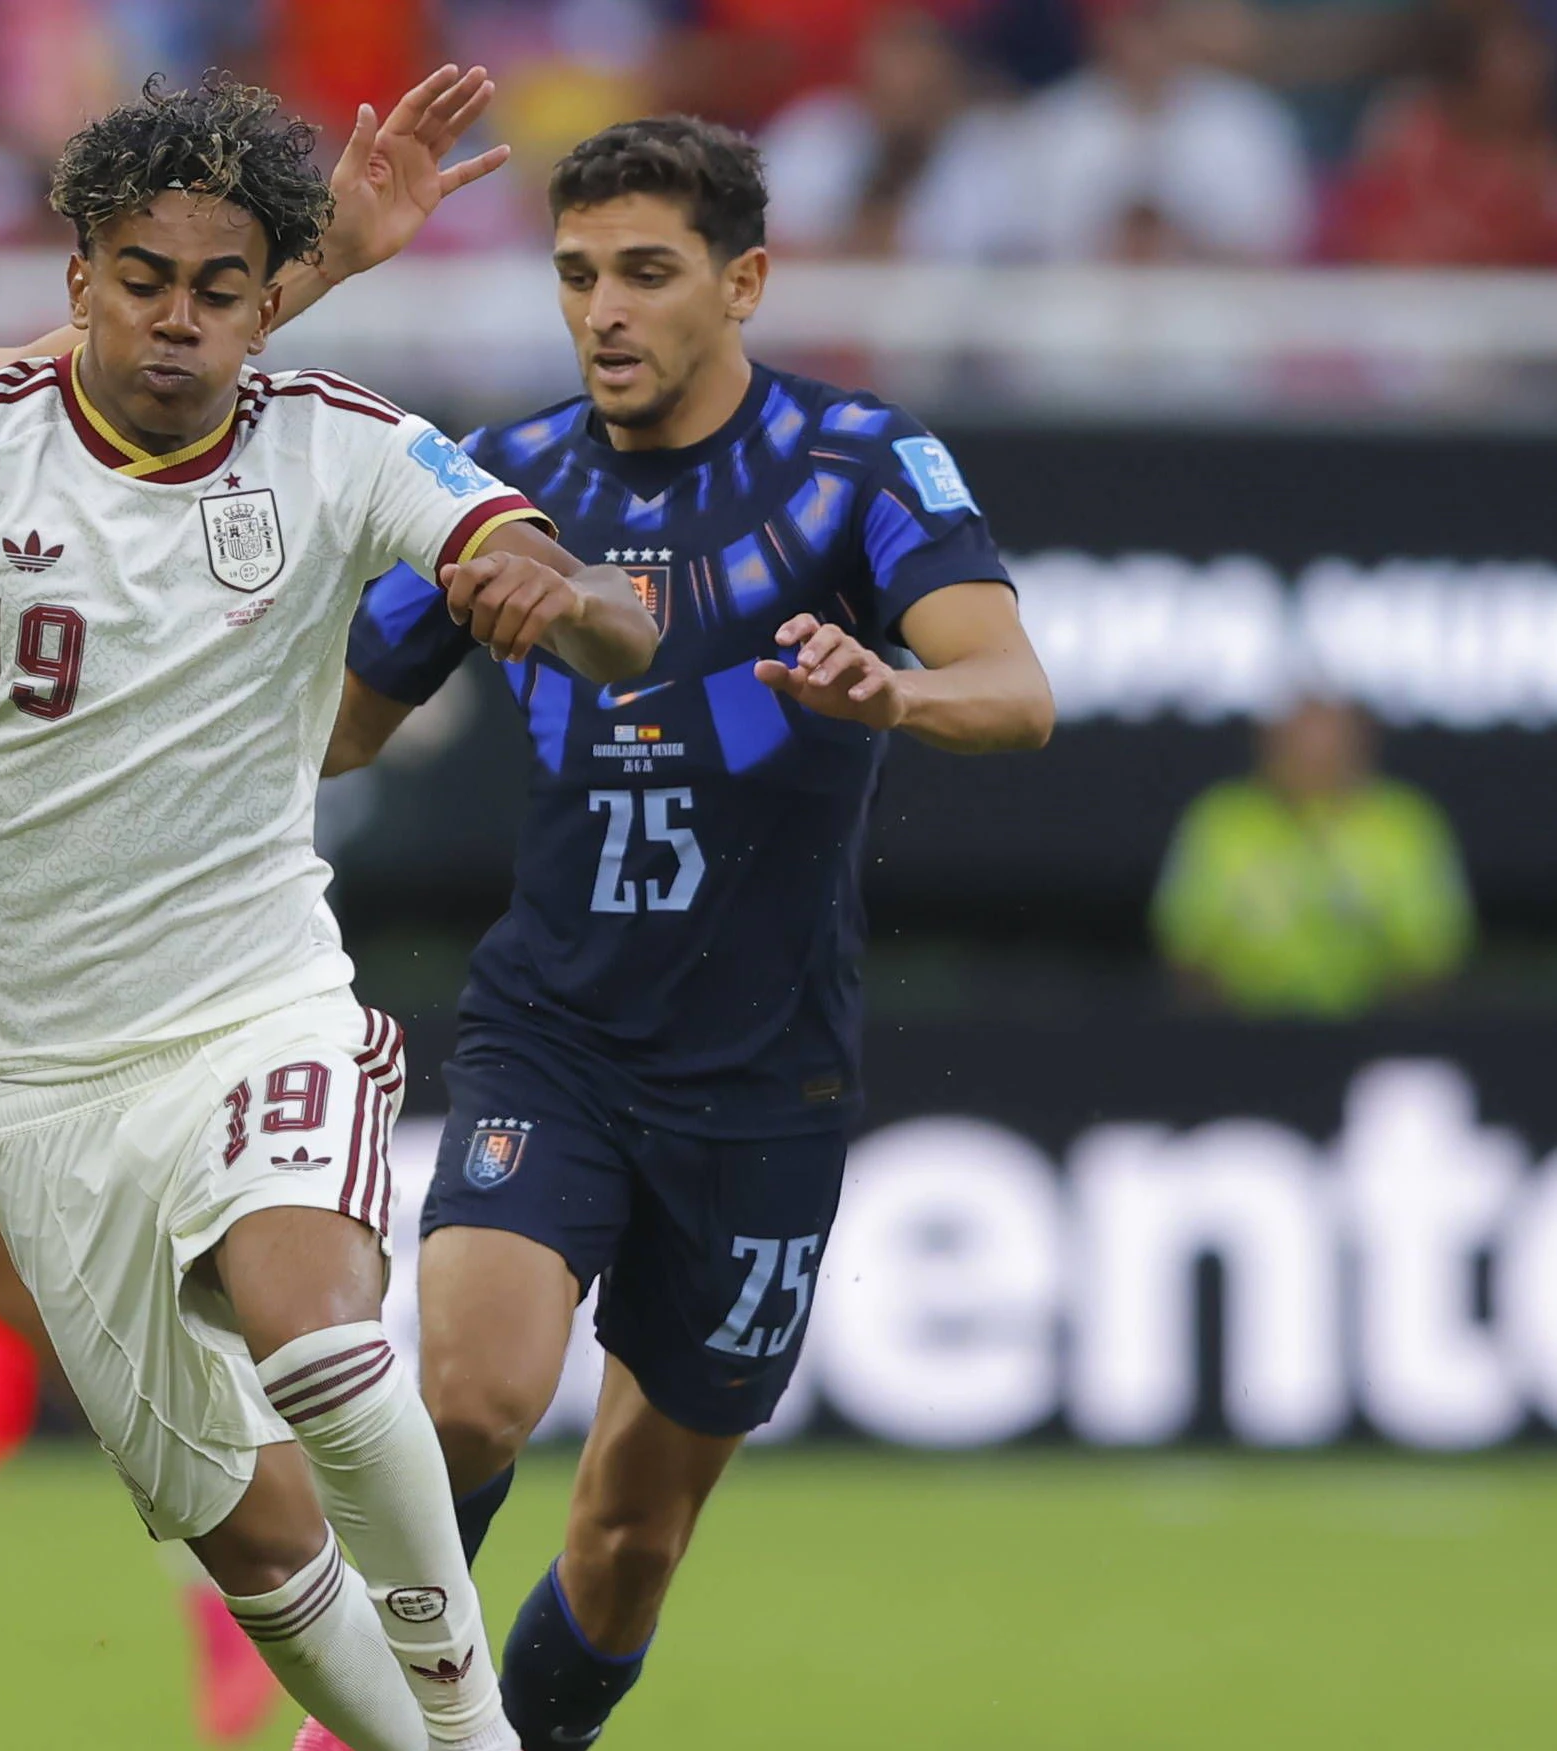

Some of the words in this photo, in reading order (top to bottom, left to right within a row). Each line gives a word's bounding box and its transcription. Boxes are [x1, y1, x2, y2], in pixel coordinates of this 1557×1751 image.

[588, 787, 707, 914] 25
[223, 1060, 332, 1170] 19
[704, 1234, 821, 1358] 25
